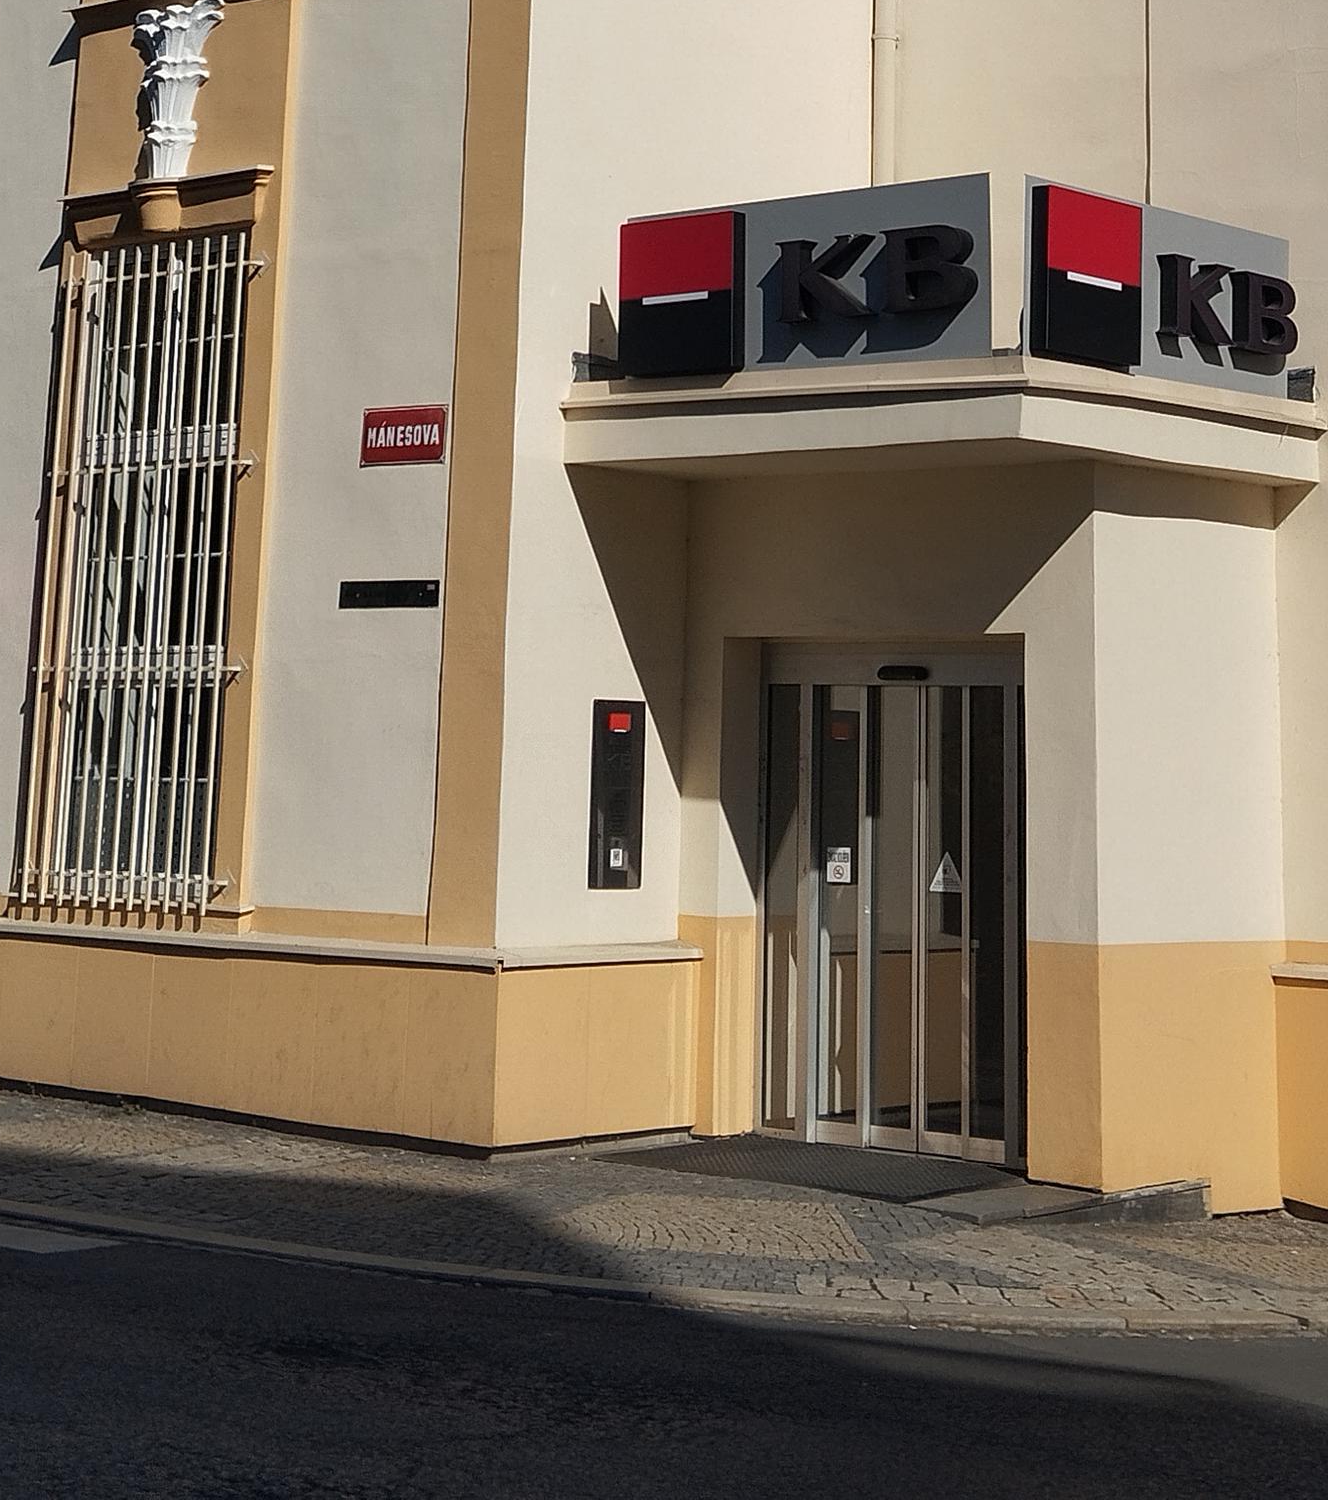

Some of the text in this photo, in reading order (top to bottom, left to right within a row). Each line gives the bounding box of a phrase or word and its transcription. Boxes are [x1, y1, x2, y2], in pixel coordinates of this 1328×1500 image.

[775, 224, 978, 325] KB
[1156, 252, 1299, 355] KB
[366, 421, 440, 449] MÁNESOVA
